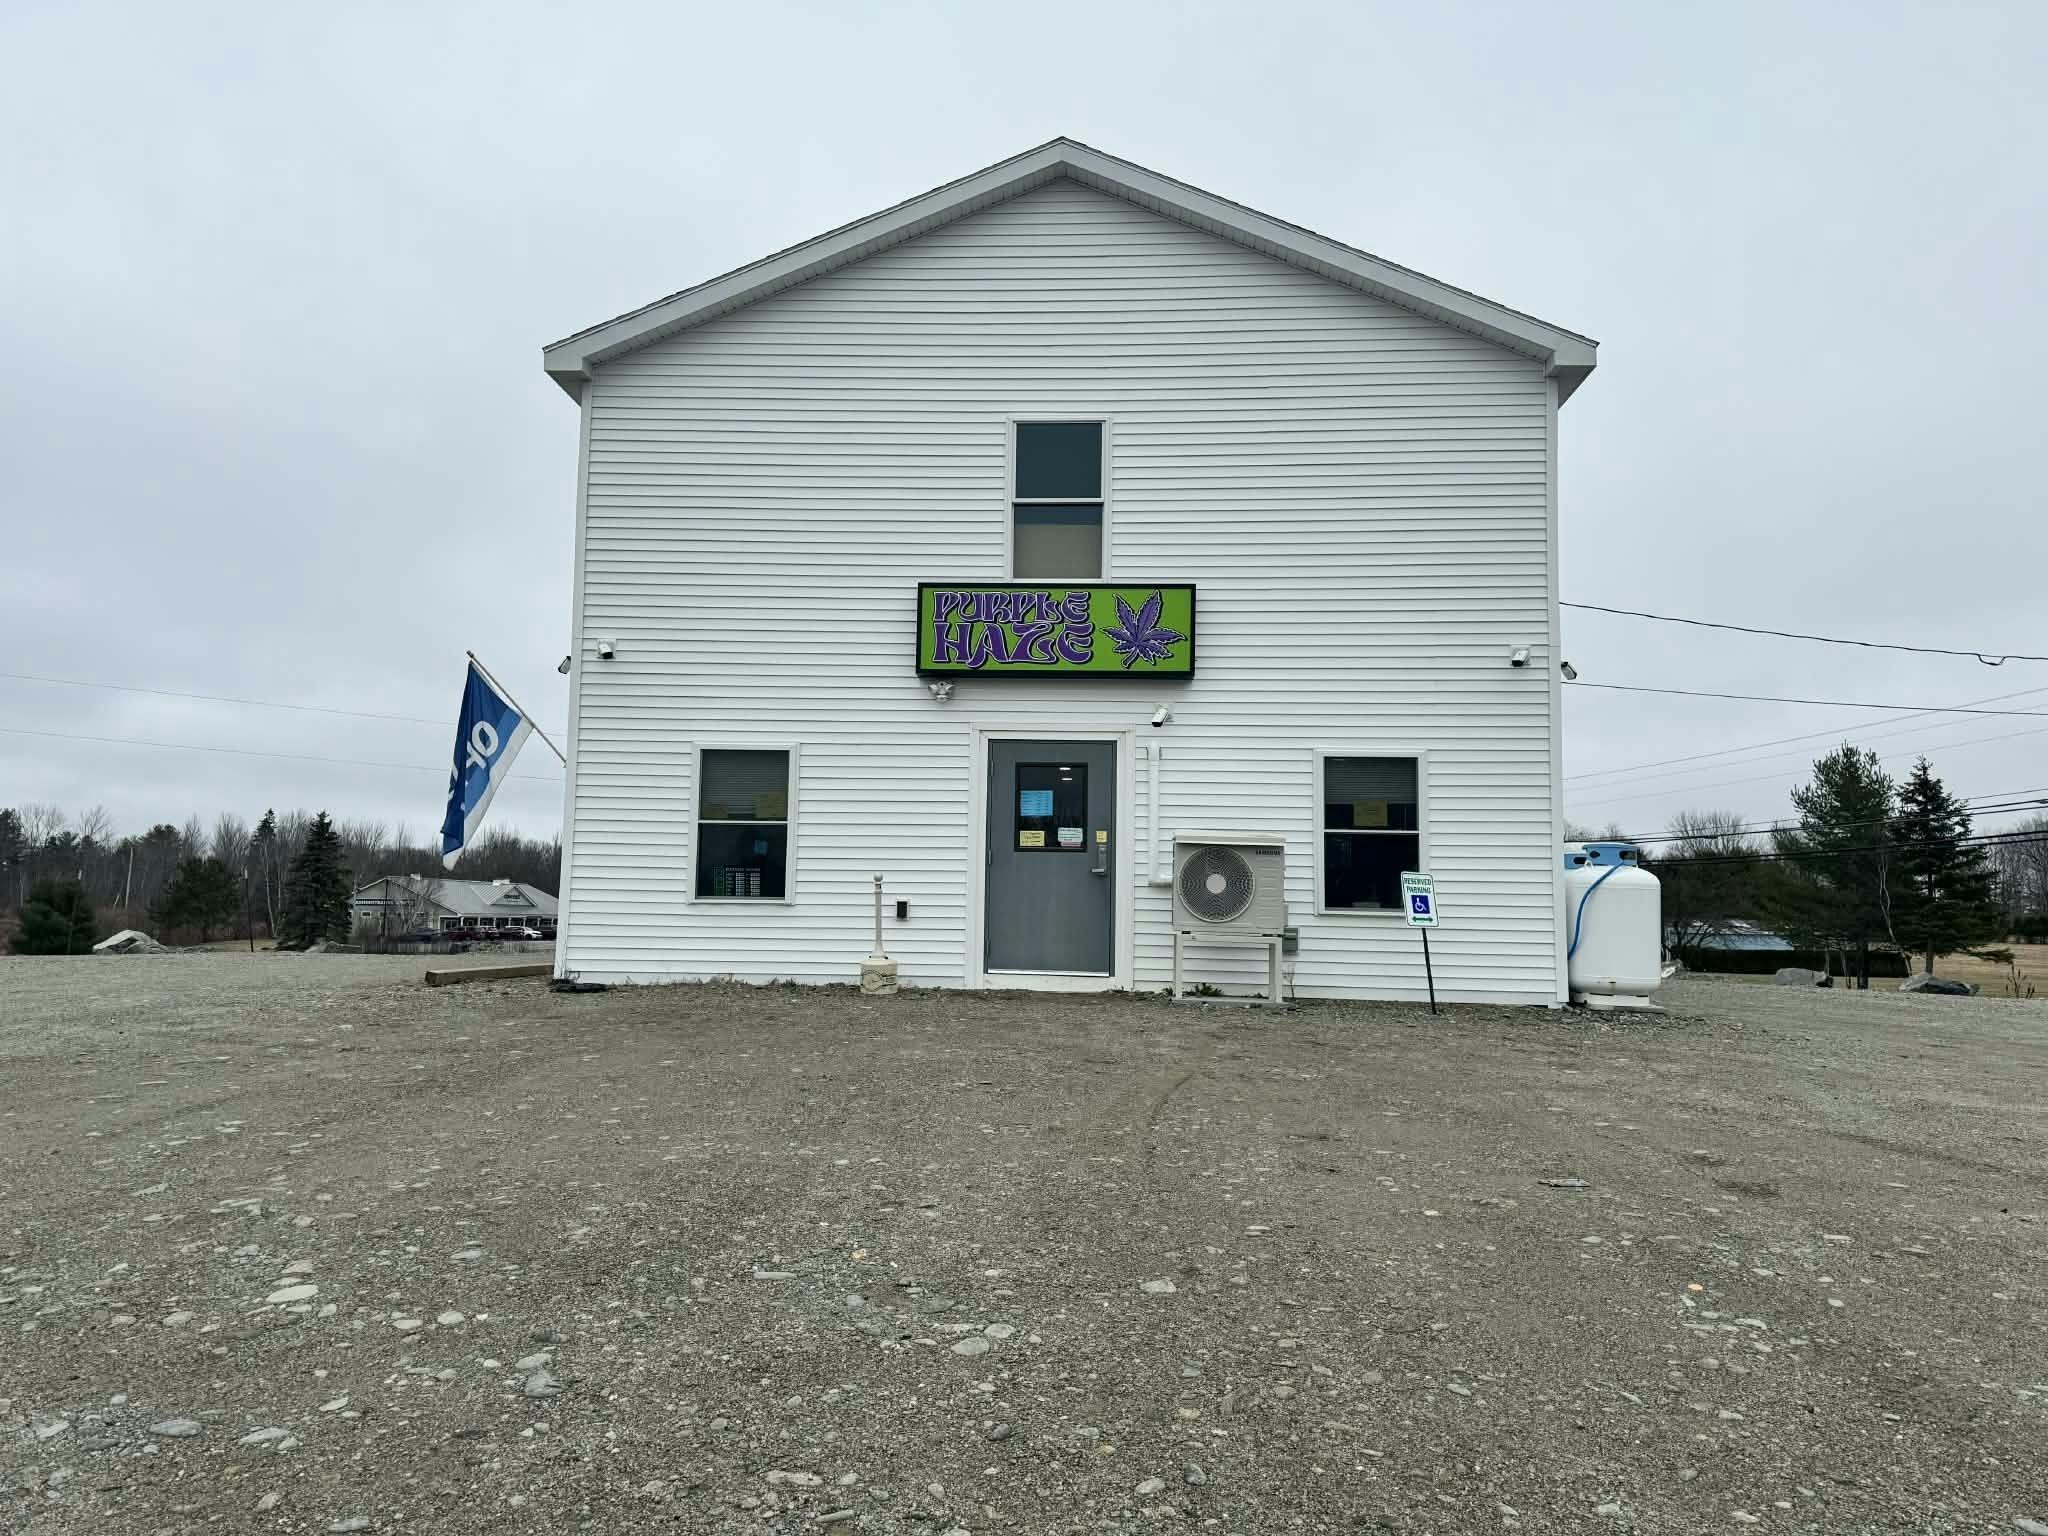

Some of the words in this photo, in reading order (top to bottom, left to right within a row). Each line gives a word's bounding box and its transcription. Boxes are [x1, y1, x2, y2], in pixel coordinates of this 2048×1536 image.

[933, 591, 1091, 622] PURPLE
[932, 622, 1095, 668] HAZE
[1404, 877, 1431, 885] RESERVED
[1406, 886, 1431, 894] PARKING
